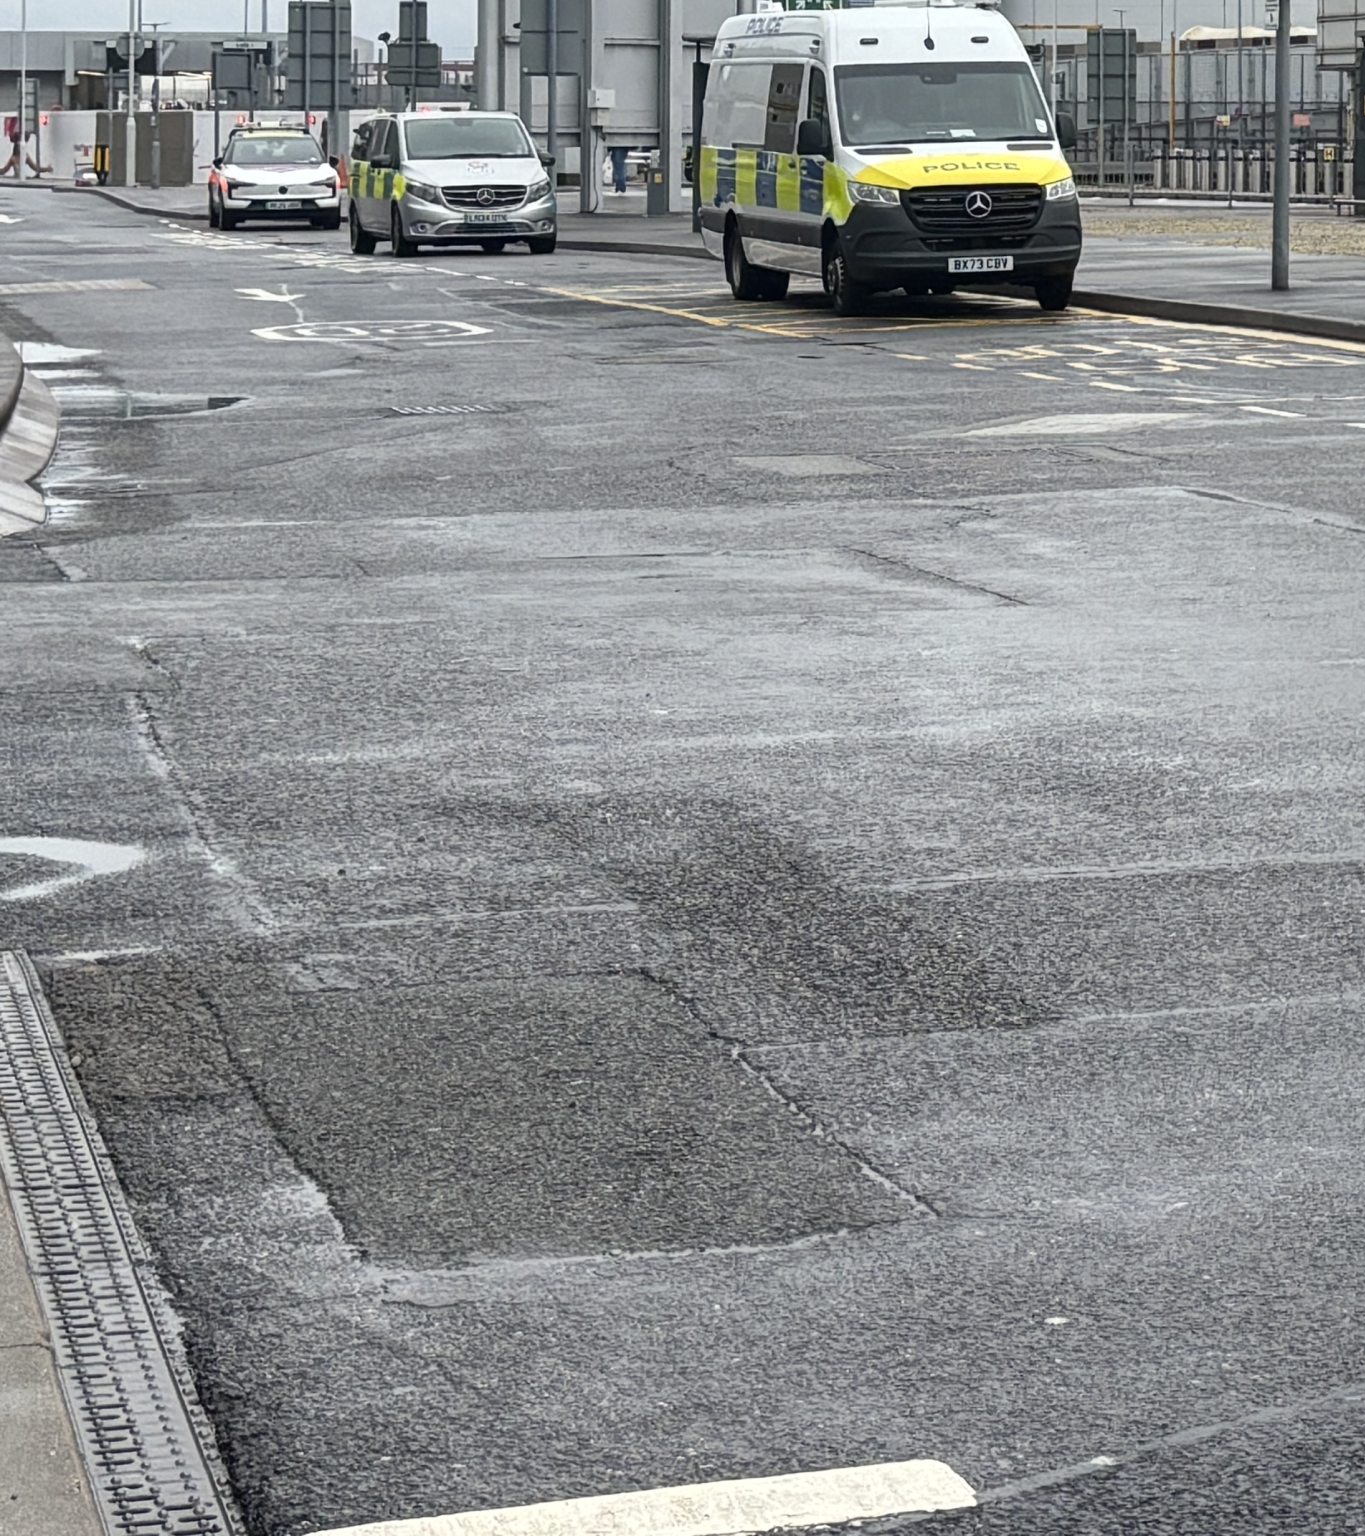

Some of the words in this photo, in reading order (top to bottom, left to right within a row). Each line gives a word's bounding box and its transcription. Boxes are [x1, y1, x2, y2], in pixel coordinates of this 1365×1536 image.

[745, 16, 785, 34] POLICE
[922, 161, 1021, 174] POLICE
[954, 258, 984, 270] BX73
[986, 257, 1008, 269] CBV
